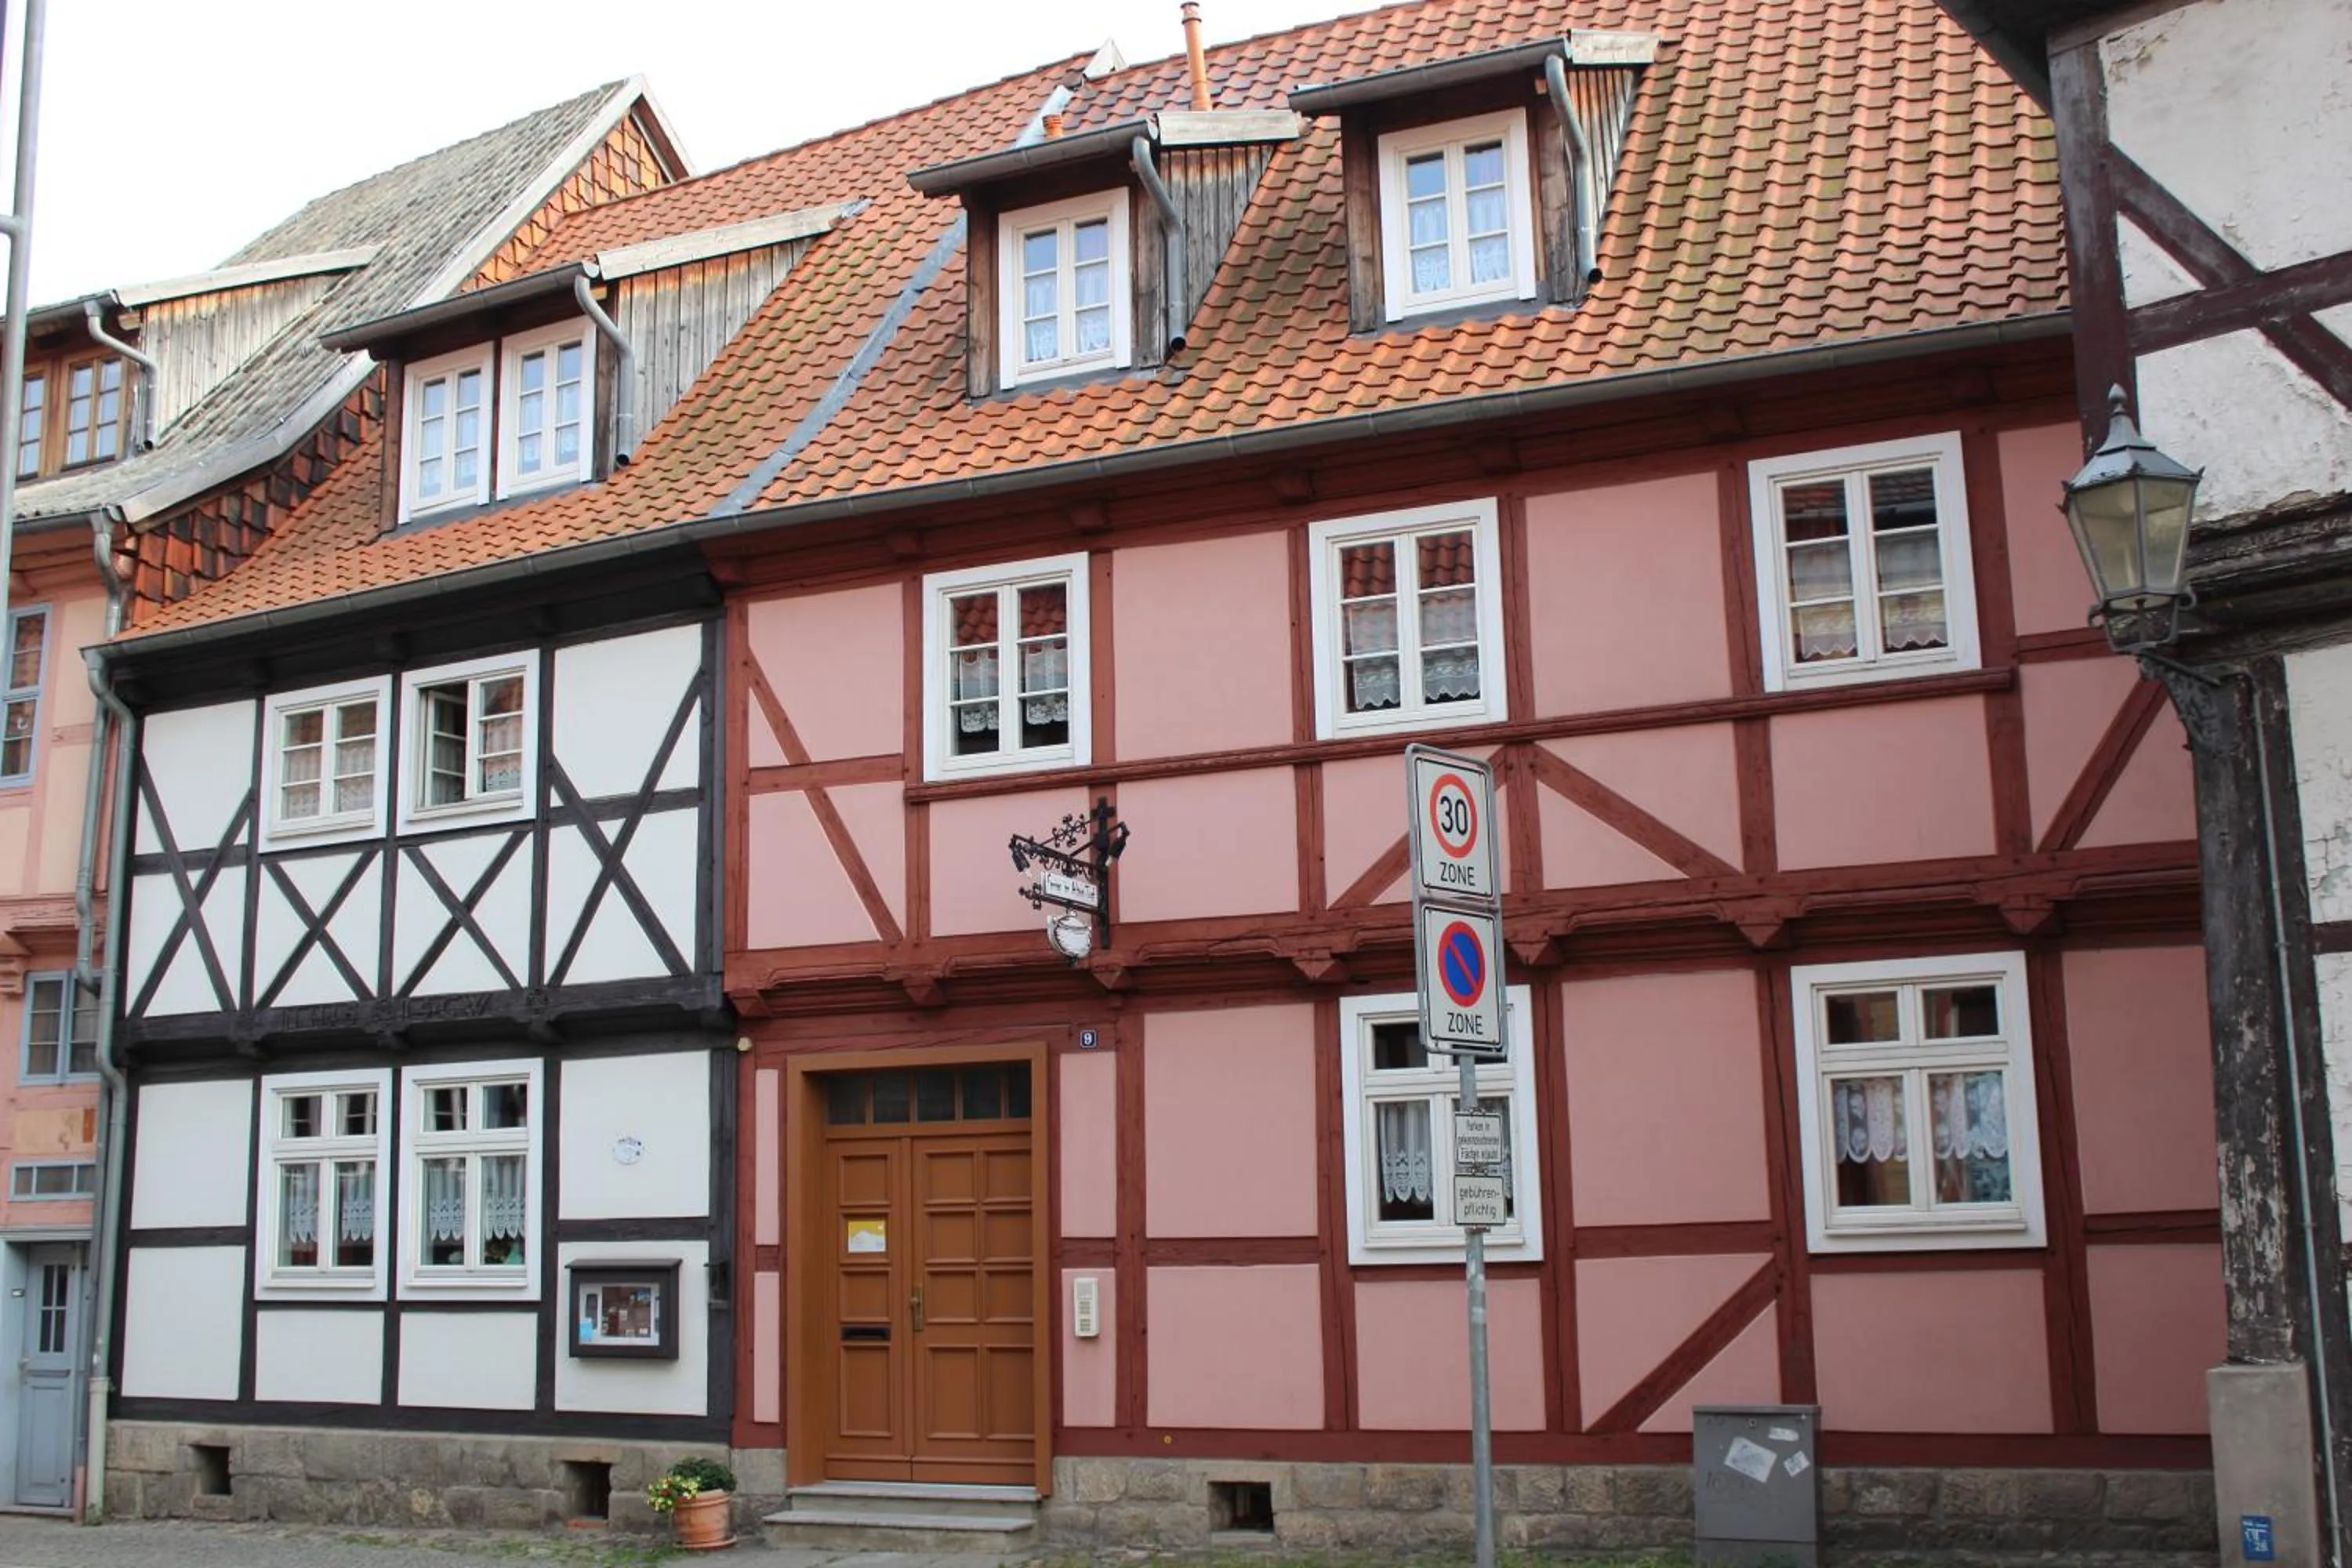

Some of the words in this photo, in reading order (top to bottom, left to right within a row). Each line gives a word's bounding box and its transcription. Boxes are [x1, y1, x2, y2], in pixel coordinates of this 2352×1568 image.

[1439, 795, 1468, 836] 30
[1439, 861, 1476, 887] ZONE
[1446, 1011, 1483, 1035] ZONE
[1083, 1033, 1092, 1045] 9
[1459, 1185, 1500, 1200] gebühren-
[1464, 1203, 1497, 1219] pflichtig
